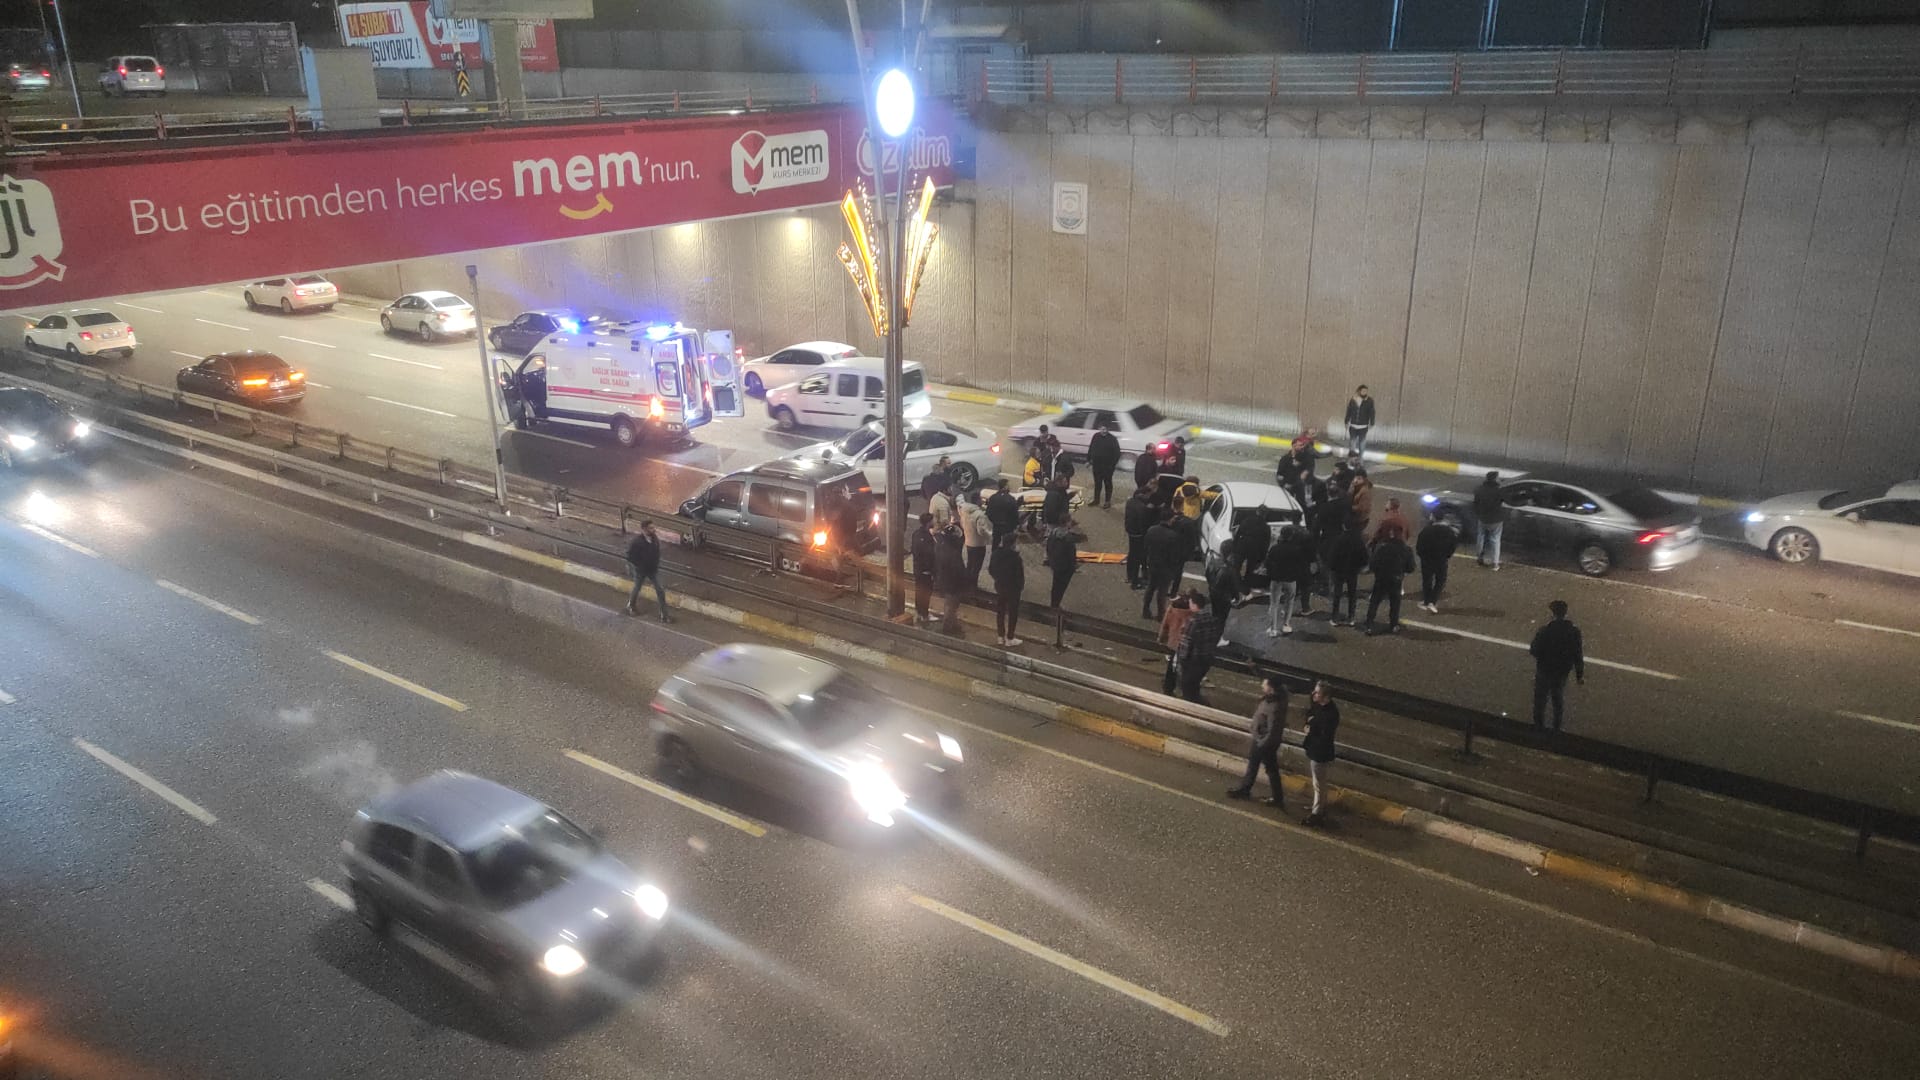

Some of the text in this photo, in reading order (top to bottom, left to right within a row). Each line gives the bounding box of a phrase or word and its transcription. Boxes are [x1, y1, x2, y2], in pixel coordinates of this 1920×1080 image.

[770, 143, 824, 168] mem
[772, 169, 792, 179] KURS
[129, 198, 188, 236] Bu
[200, 182, 388, 236] eğitimden
[396, 173, 503, 209] herkes
